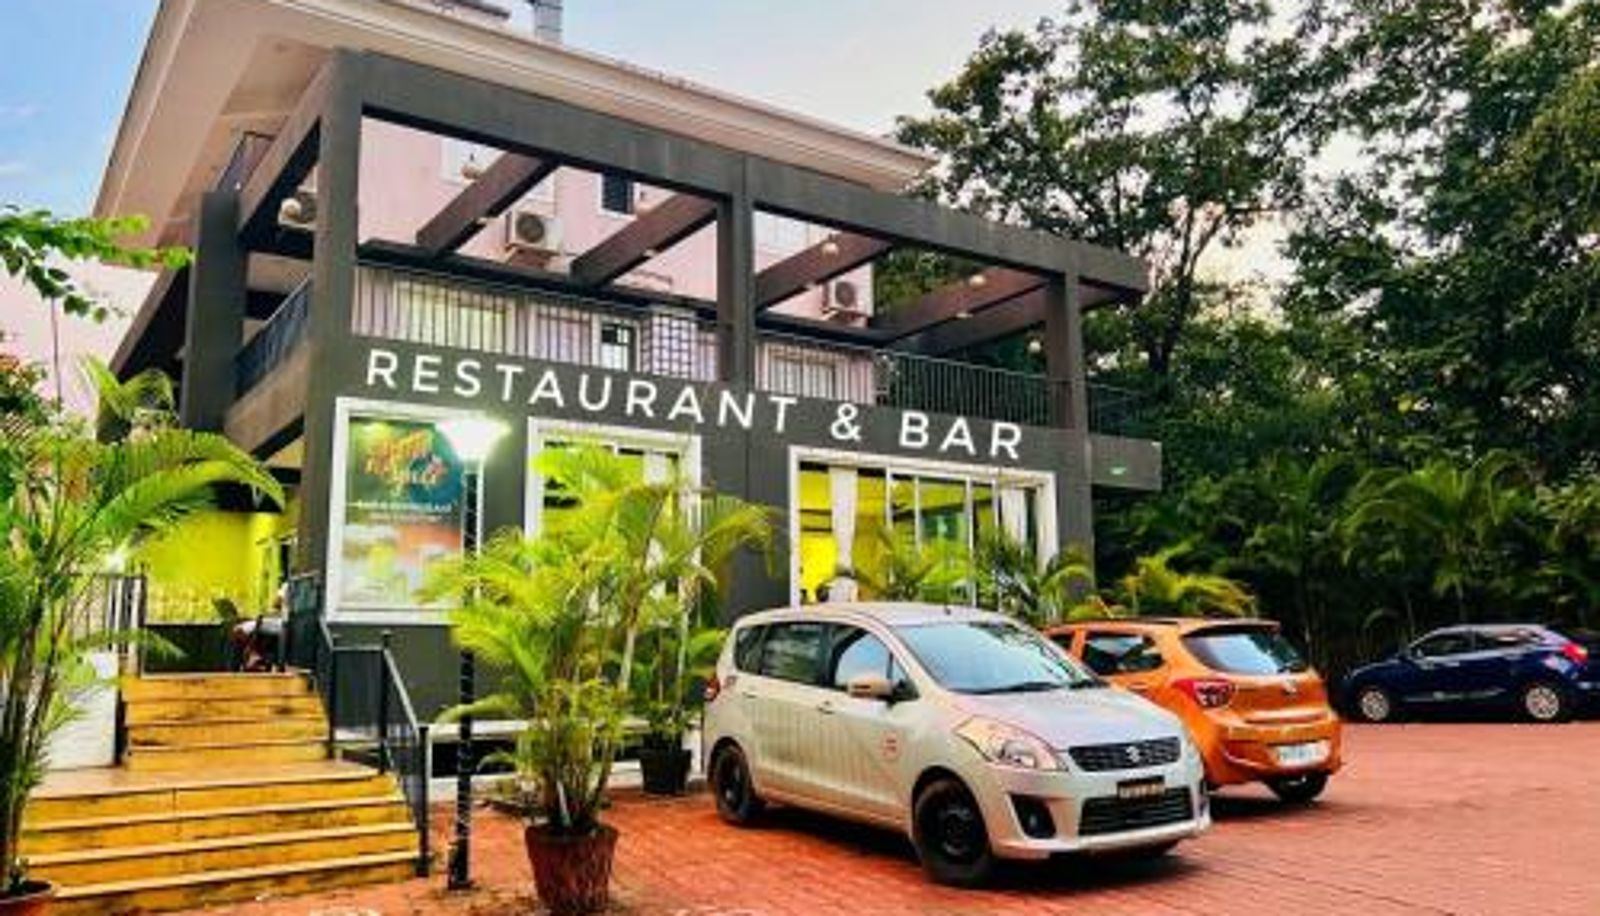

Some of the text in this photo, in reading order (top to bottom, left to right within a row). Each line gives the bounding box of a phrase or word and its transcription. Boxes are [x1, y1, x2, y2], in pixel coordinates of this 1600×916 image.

[366, 348, 1022, 460] RESTAURANT & BAR
